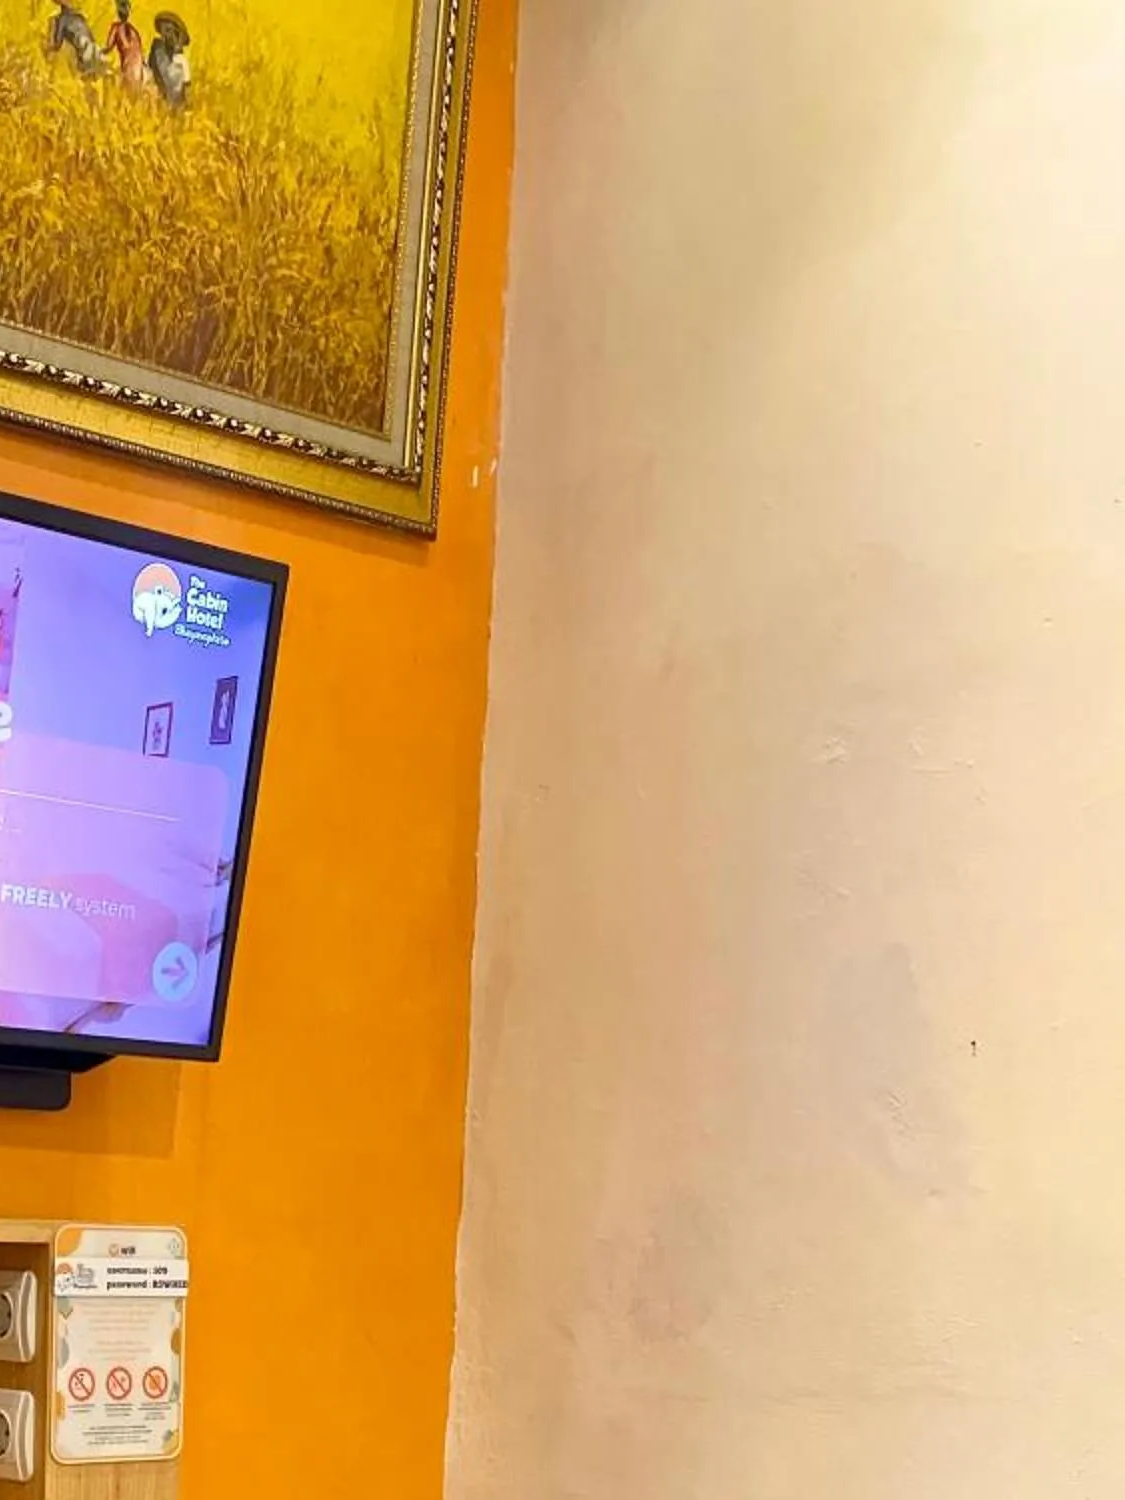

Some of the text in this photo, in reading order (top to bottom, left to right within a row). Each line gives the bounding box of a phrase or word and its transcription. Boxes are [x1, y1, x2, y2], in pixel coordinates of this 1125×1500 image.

[186, 587, 229, 613] Cabin
[186, 606, 224, 630] Hotel
[0, 883, 74, 910] FREELY
[74, 895, 138, 921] system
